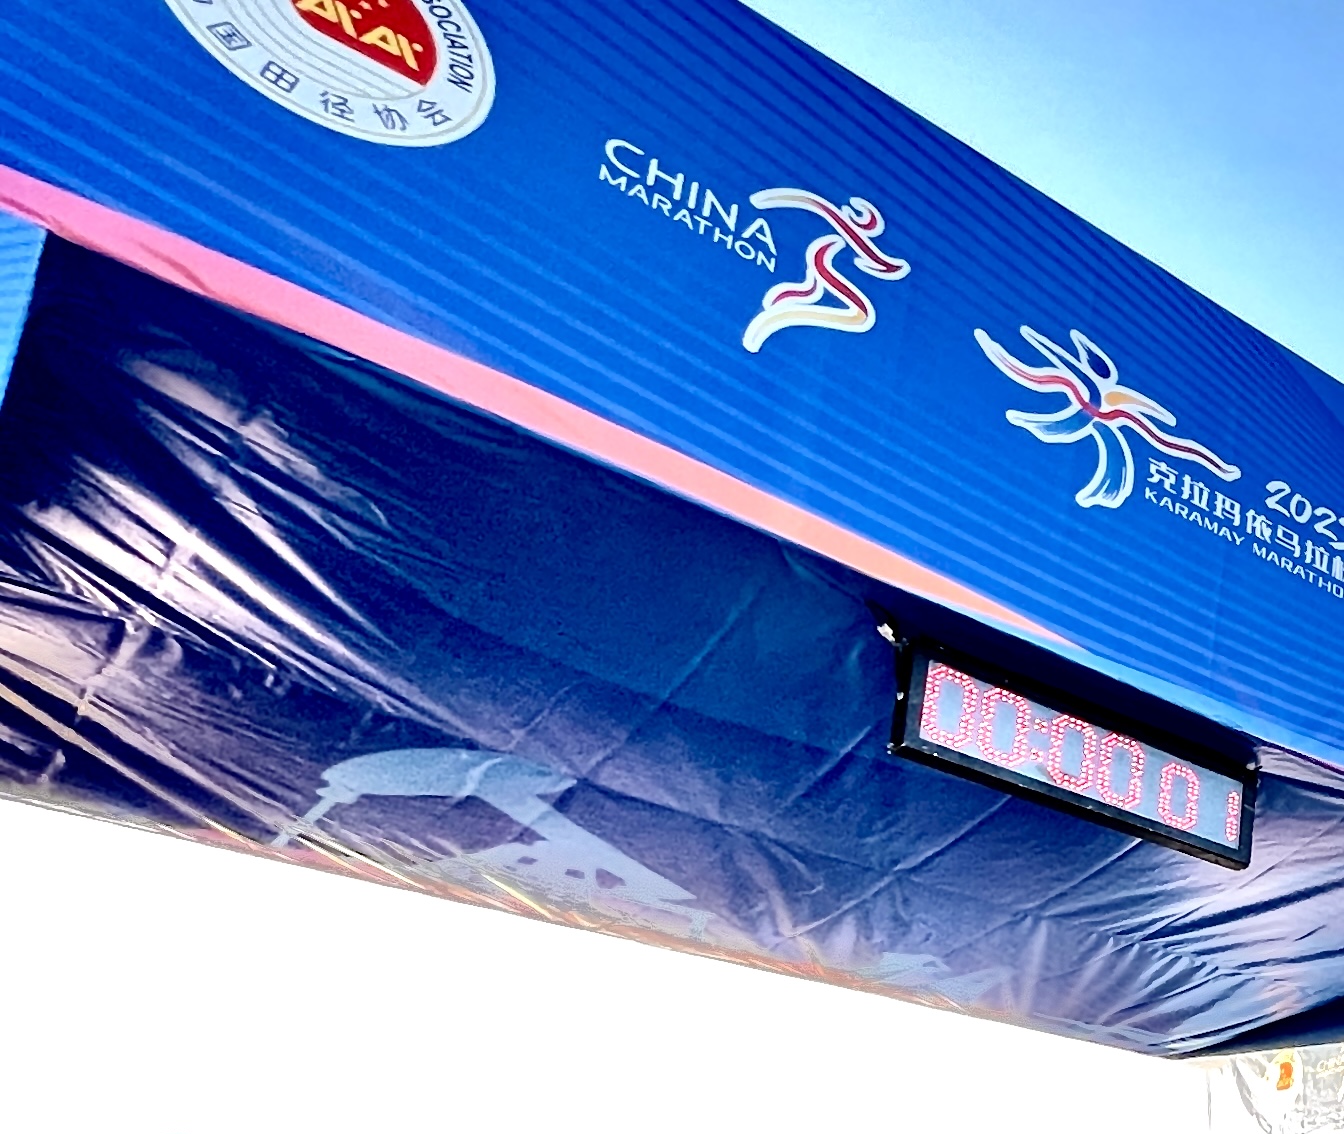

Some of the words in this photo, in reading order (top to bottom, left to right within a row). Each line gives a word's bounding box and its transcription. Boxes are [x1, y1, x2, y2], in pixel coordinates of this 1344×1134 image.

[192, 0, 452, 131] 国田径协会
[599, 164, 776, 272] MARATHON
[604, 138, 777, 256] CHINA
[1144, 487, 1246, 546] KARAMAY
